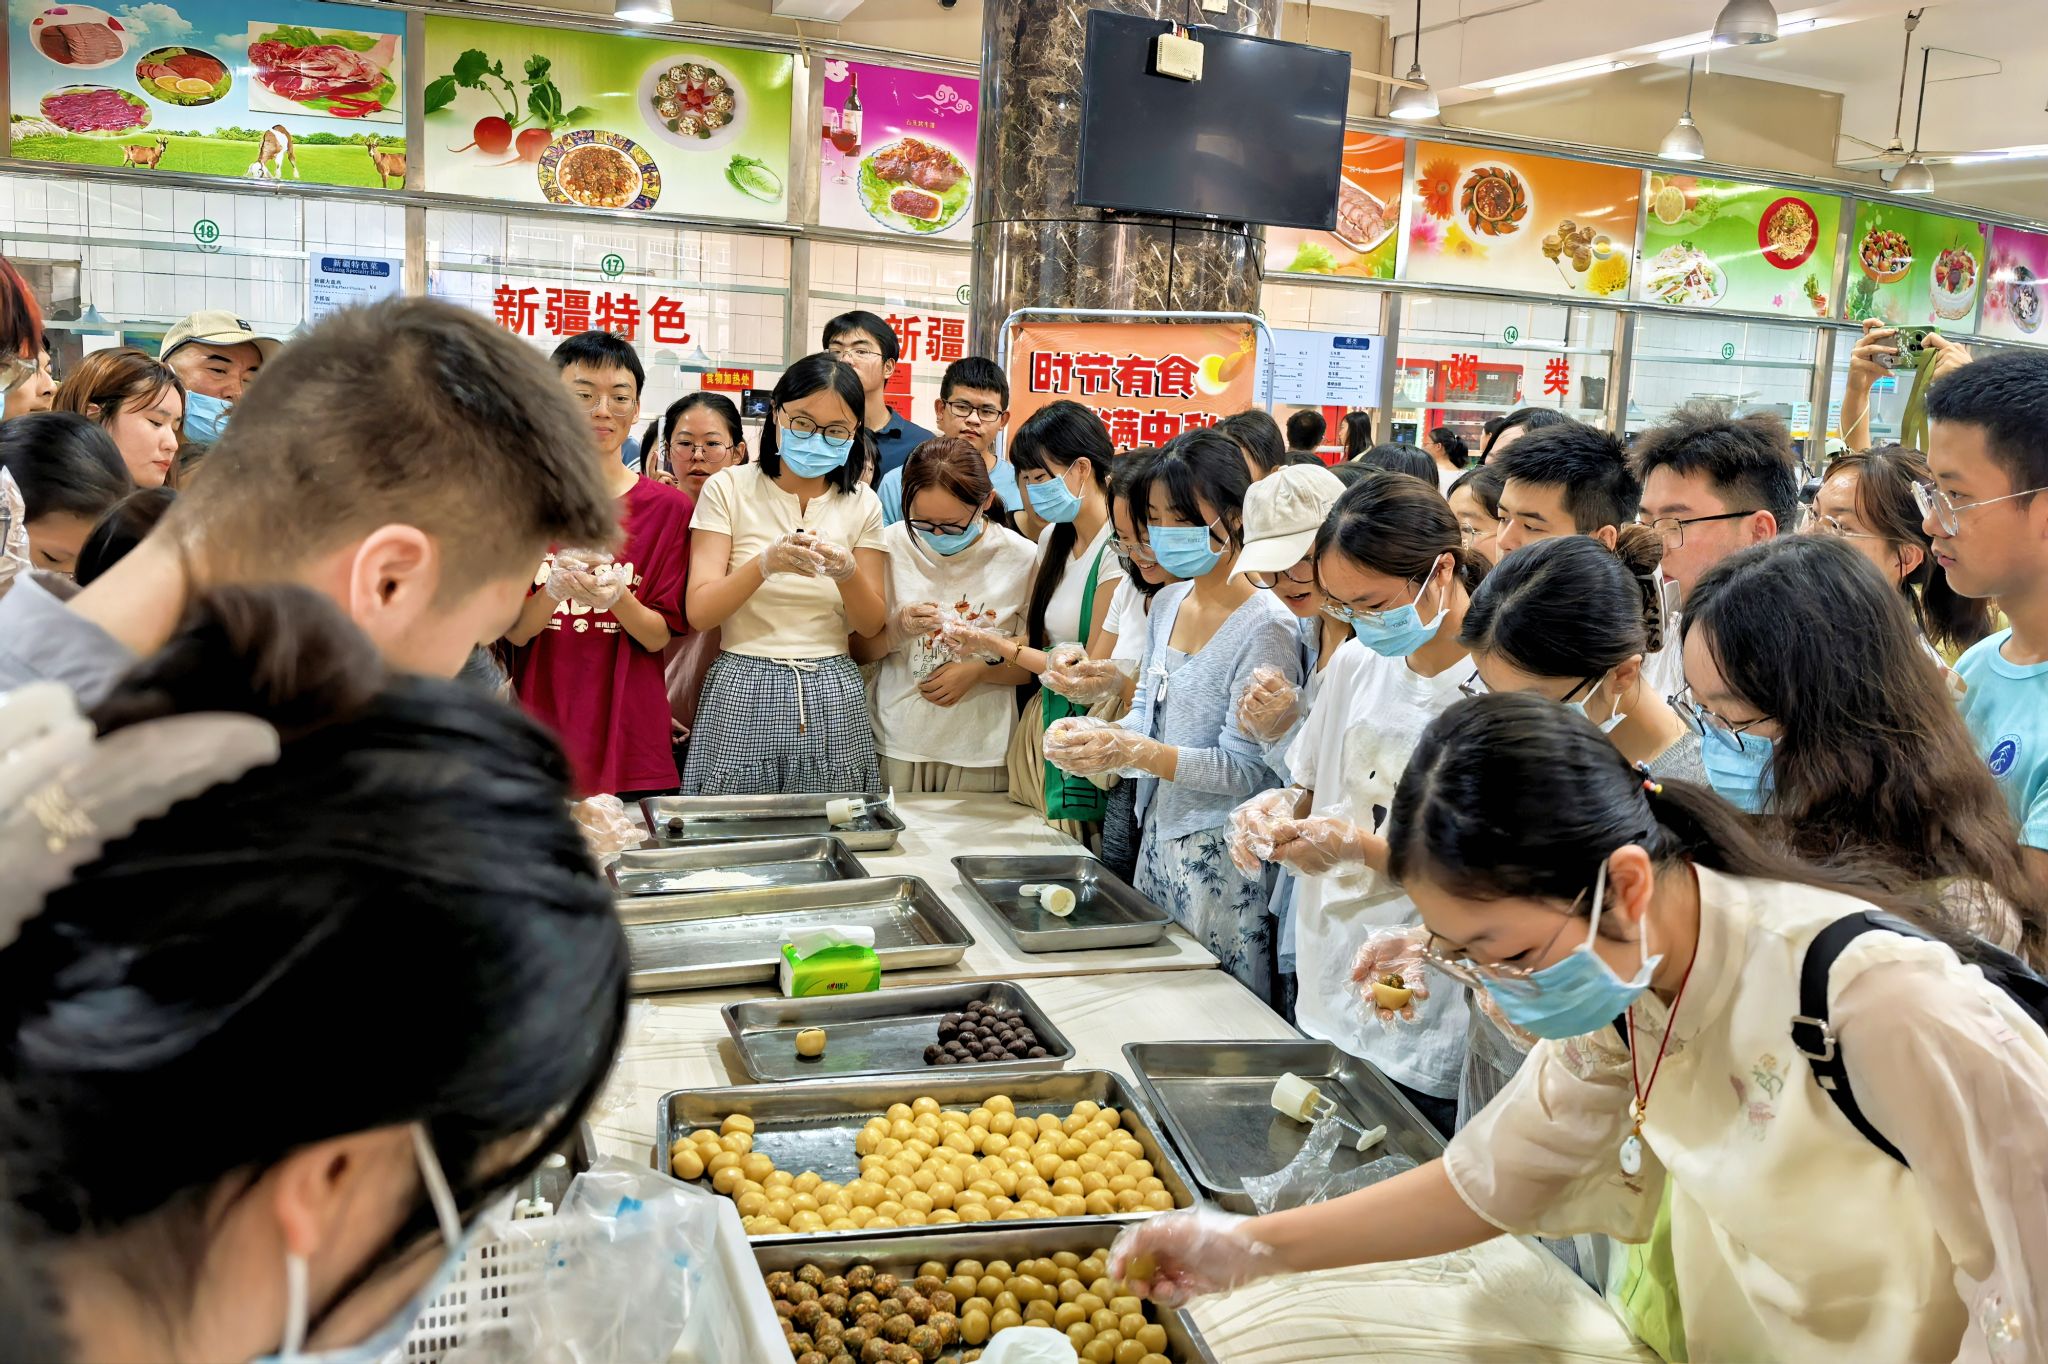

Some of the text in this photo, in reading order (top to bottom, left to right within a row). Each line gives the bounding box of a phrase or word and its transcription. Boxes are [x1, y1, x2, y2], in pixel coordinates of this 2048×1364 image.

[198, 224, 214, 239] 18
[605, 258, 620, 272] 17
[493, 283, 691, 345] 新疆特色
[884, 313, 965, 363] 新疆
[1506, 329, 1516, 341] 14
[1724, 345, 1733, 357] 13
[706, 371, 750, 386] 食物加热处
[1030, 351, 1200, 399] 时节有食
